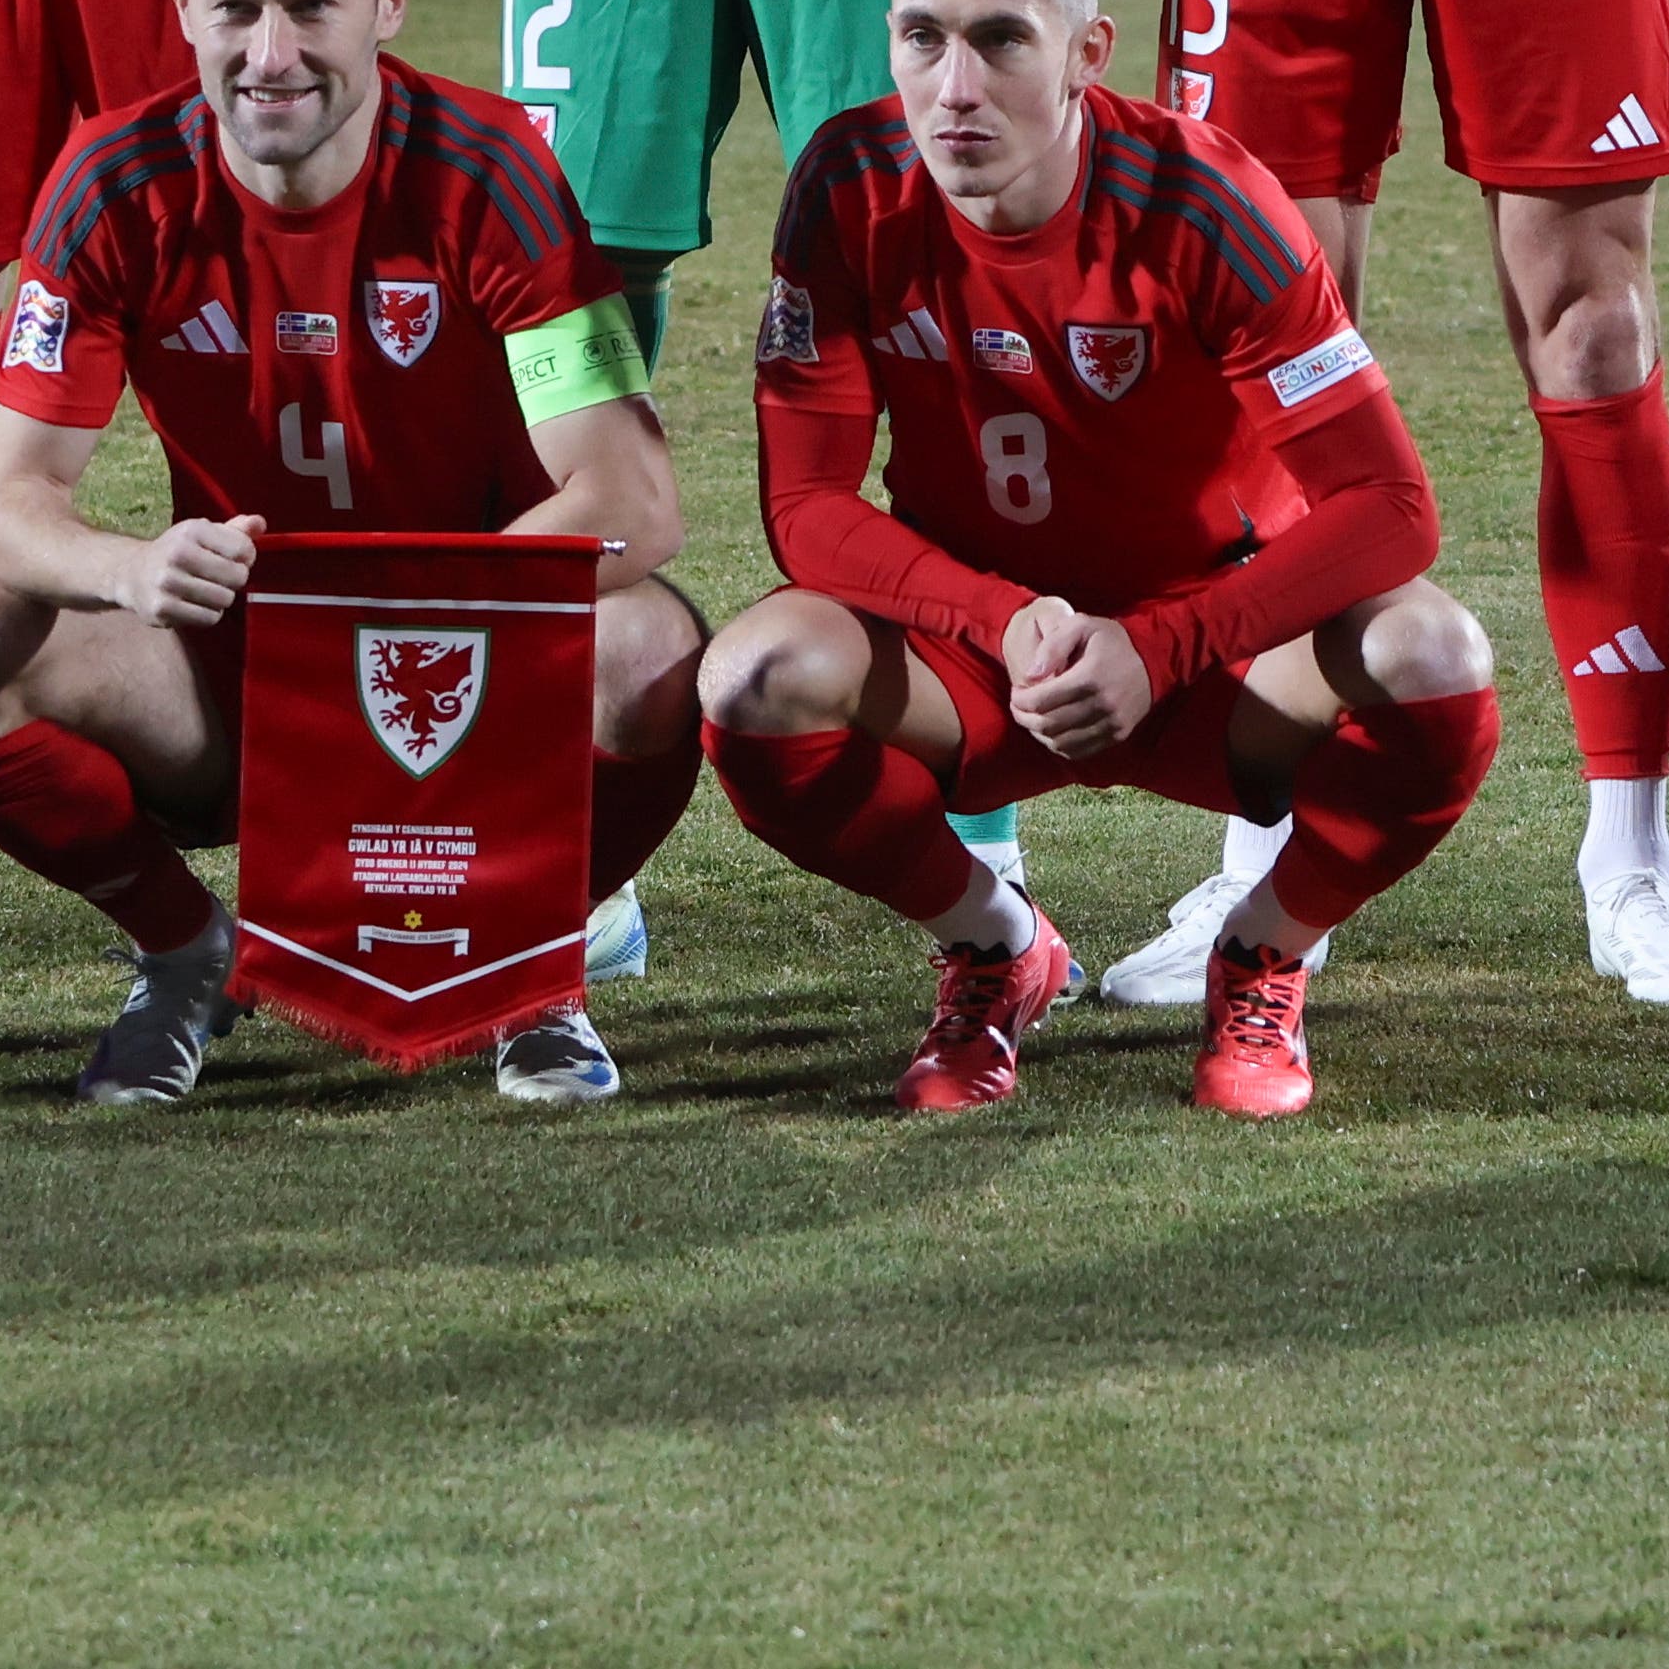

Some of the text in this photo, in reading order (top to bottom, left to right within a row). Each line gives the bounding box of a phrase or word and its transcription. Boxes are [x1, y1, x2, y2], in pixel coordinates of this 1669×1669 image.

[1272, 363, 1298, 380] UEFA
[279, 402, 353, 510] 4
[979, 413, 1053, 525] 8
[348, 839, 389, 853] GWLAD
[391, 840, 406, 854] YR
[426, 840, 434, 854] V
[436, 841, 477, 856] CYMRU
[448, 861, 468, 870] 2024
